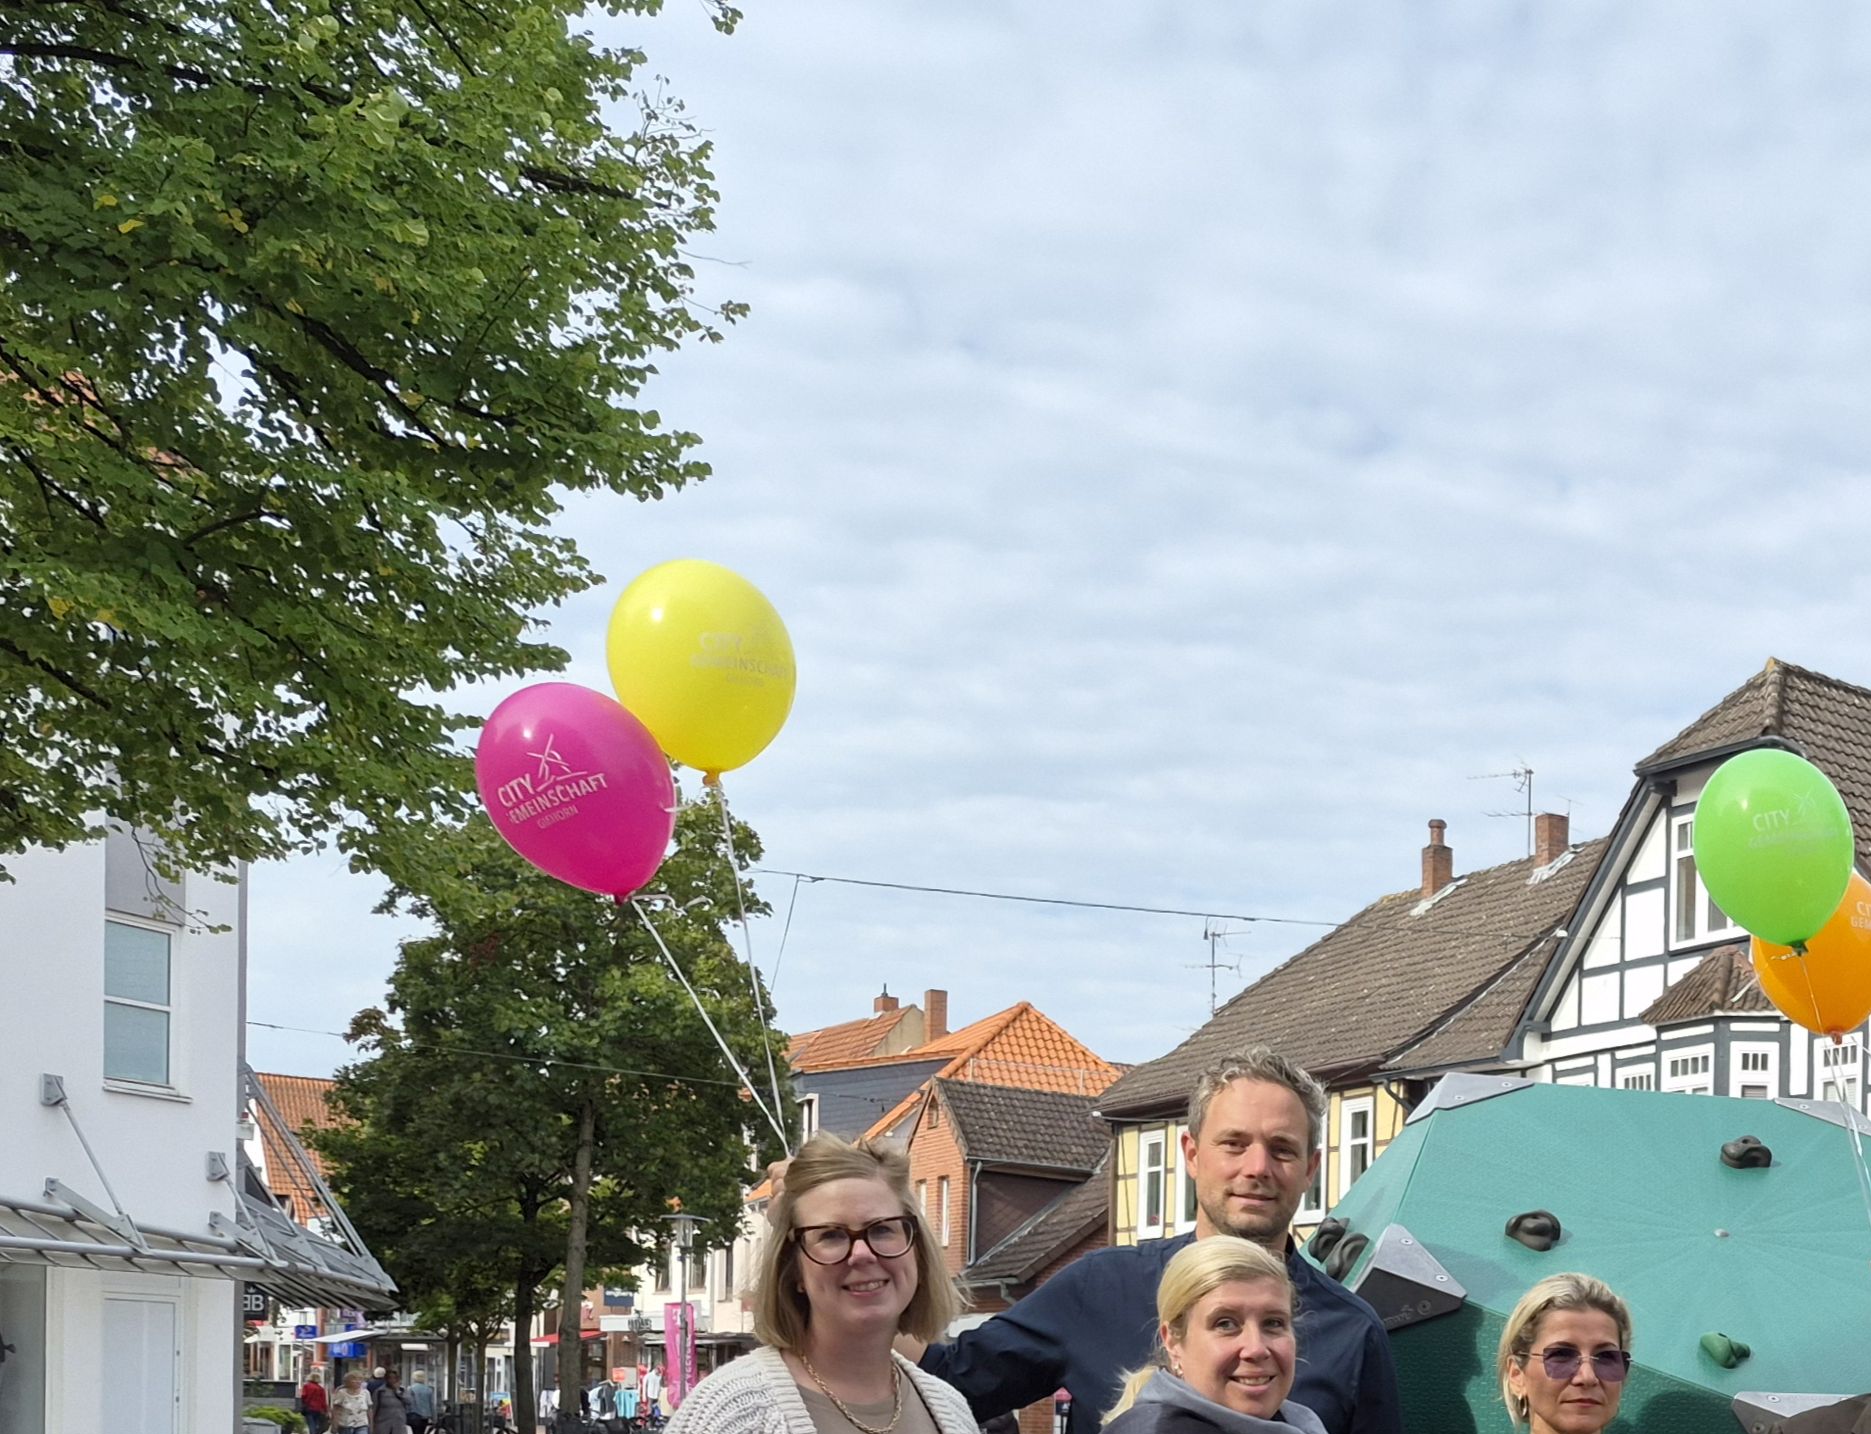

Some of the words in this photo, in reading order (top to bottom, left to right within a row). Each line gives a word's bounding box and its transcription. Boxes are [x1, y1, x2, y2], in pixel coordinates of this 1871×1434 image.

[498, 773, 535, 807] CITY
[506, 773, 608, 824] EMEINSCHAFT
[1753, 809, 1790, 832] CITY
